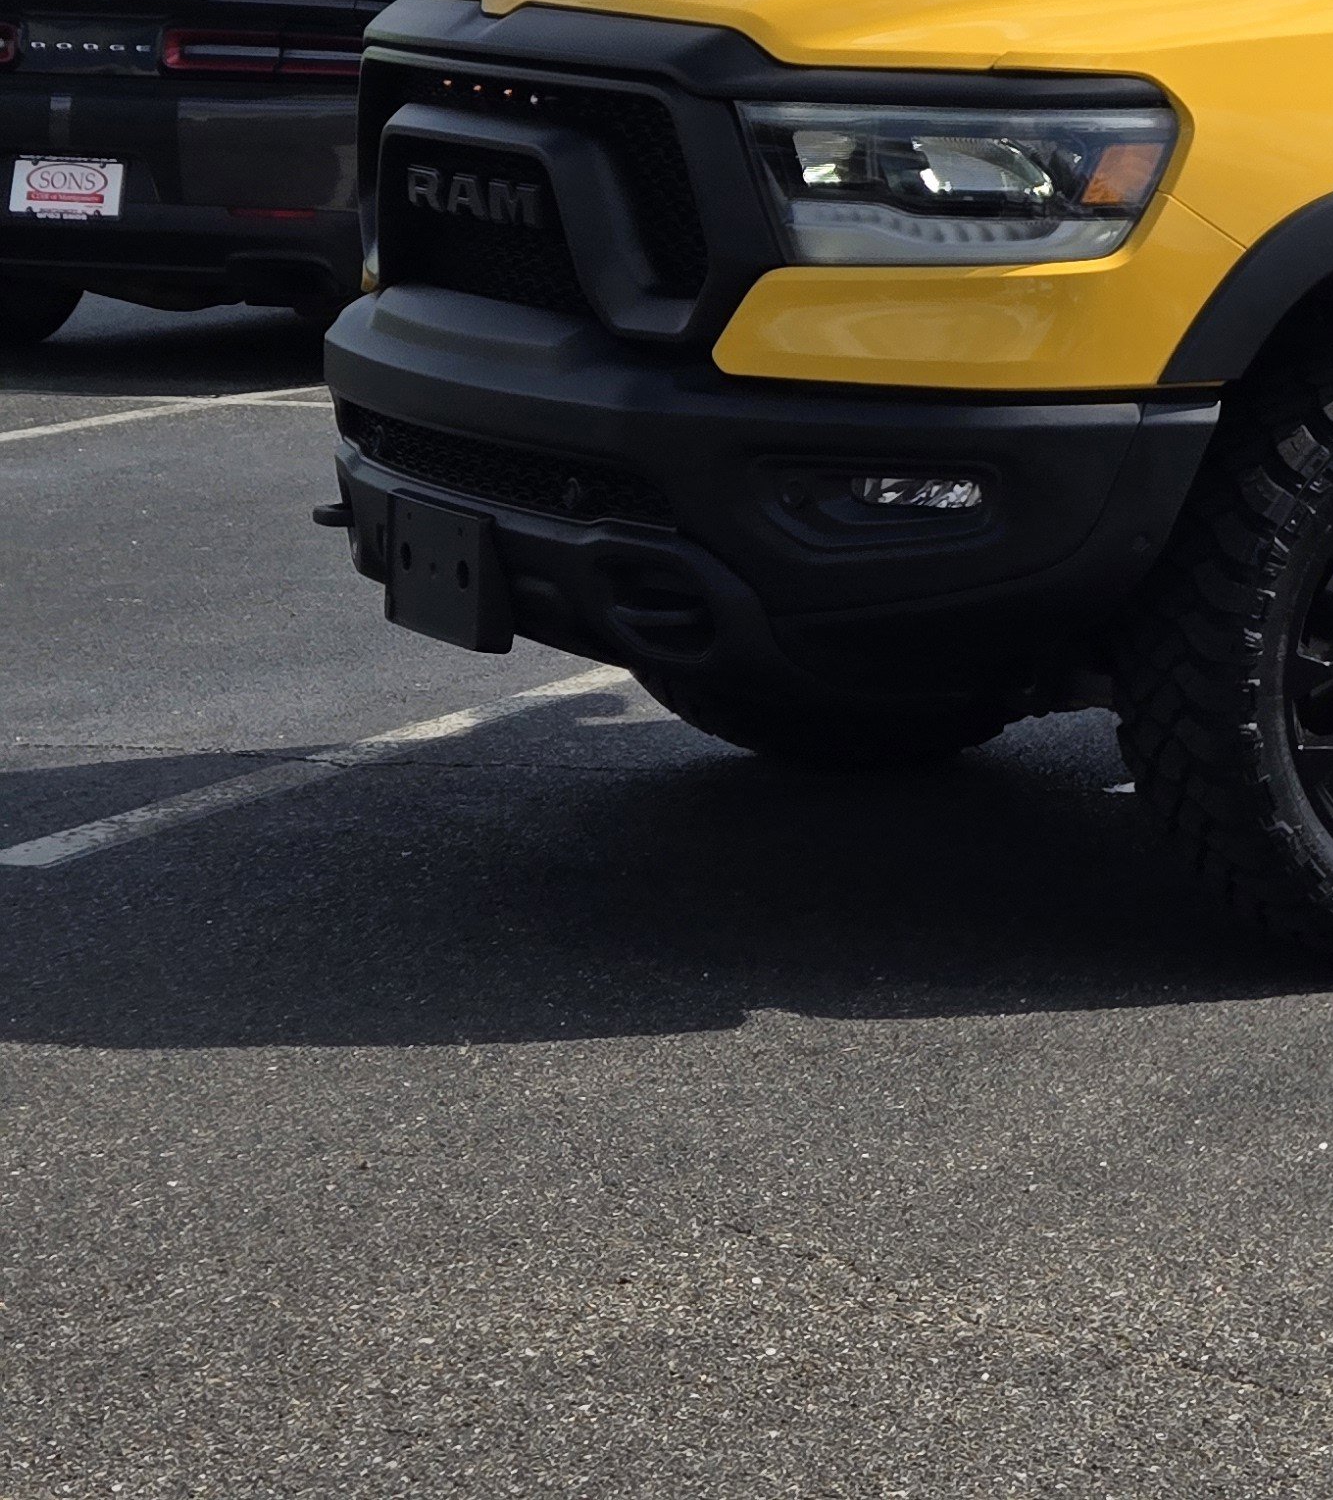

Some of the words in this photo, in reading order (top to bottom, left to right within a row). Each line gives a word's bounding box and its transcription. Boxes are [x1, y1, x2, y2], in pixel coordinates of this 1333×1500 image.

[30, 40, 151, 52] DODGE
[39, 170, 96, 191] SONS
[407, 164, 542, 230] RAM
